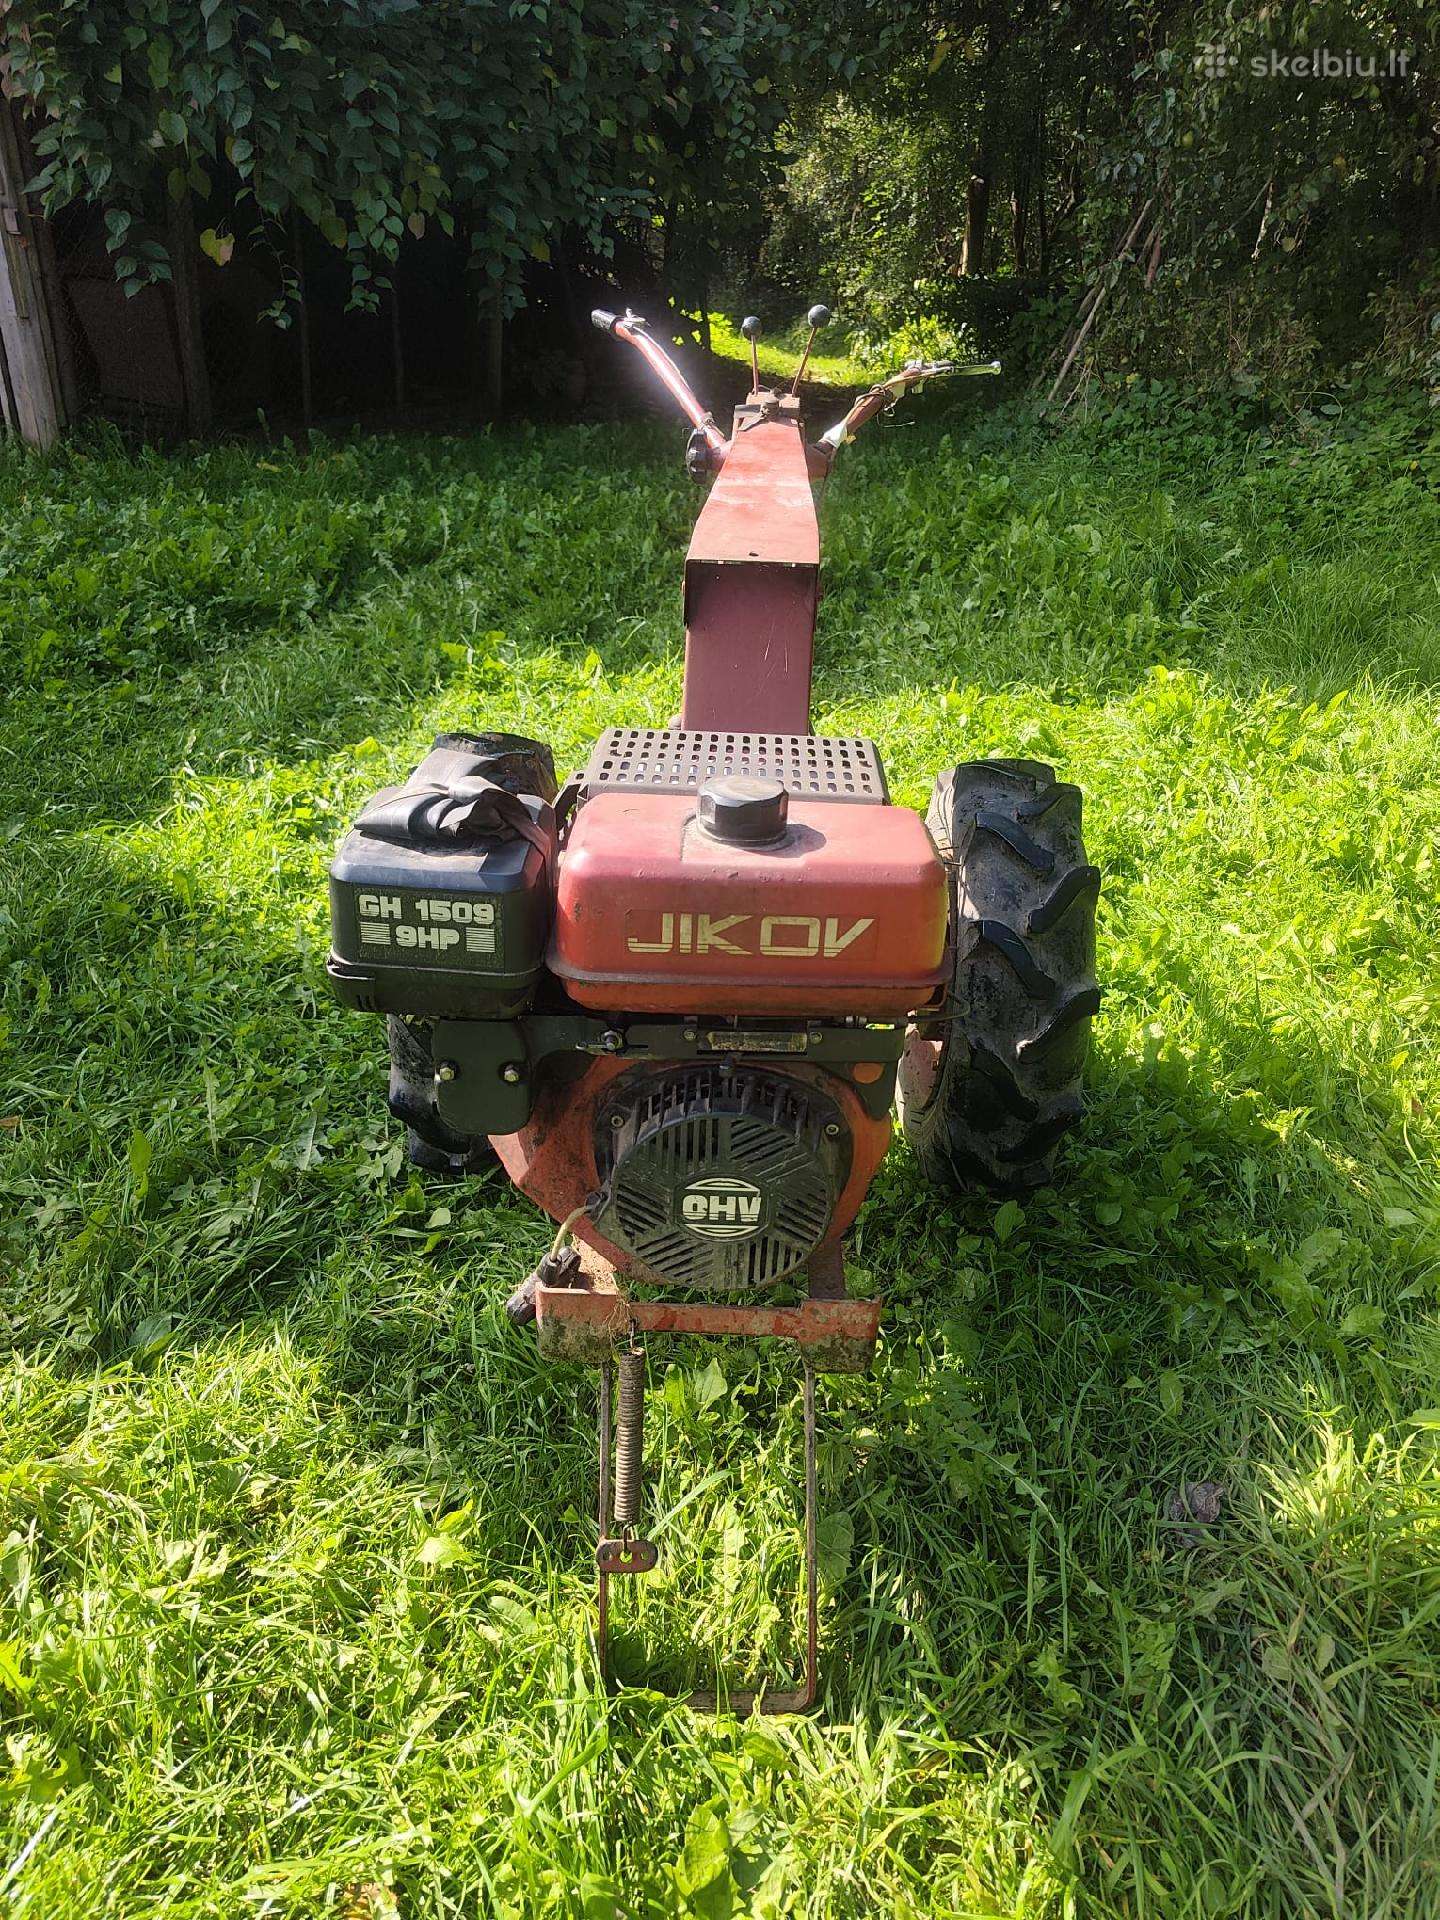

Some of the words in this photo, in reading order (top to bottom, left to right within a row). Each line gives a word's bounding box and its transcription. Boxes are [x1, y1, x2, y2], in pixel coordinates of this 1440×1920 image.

[359, 894, 402, 919] GH
[415, 899, 495, 925] 1509
[395, 925, 460, 950] 9HP
[627, 912, 876, 958] JIKOV
[682, 1194, 762, 1222] OHV
